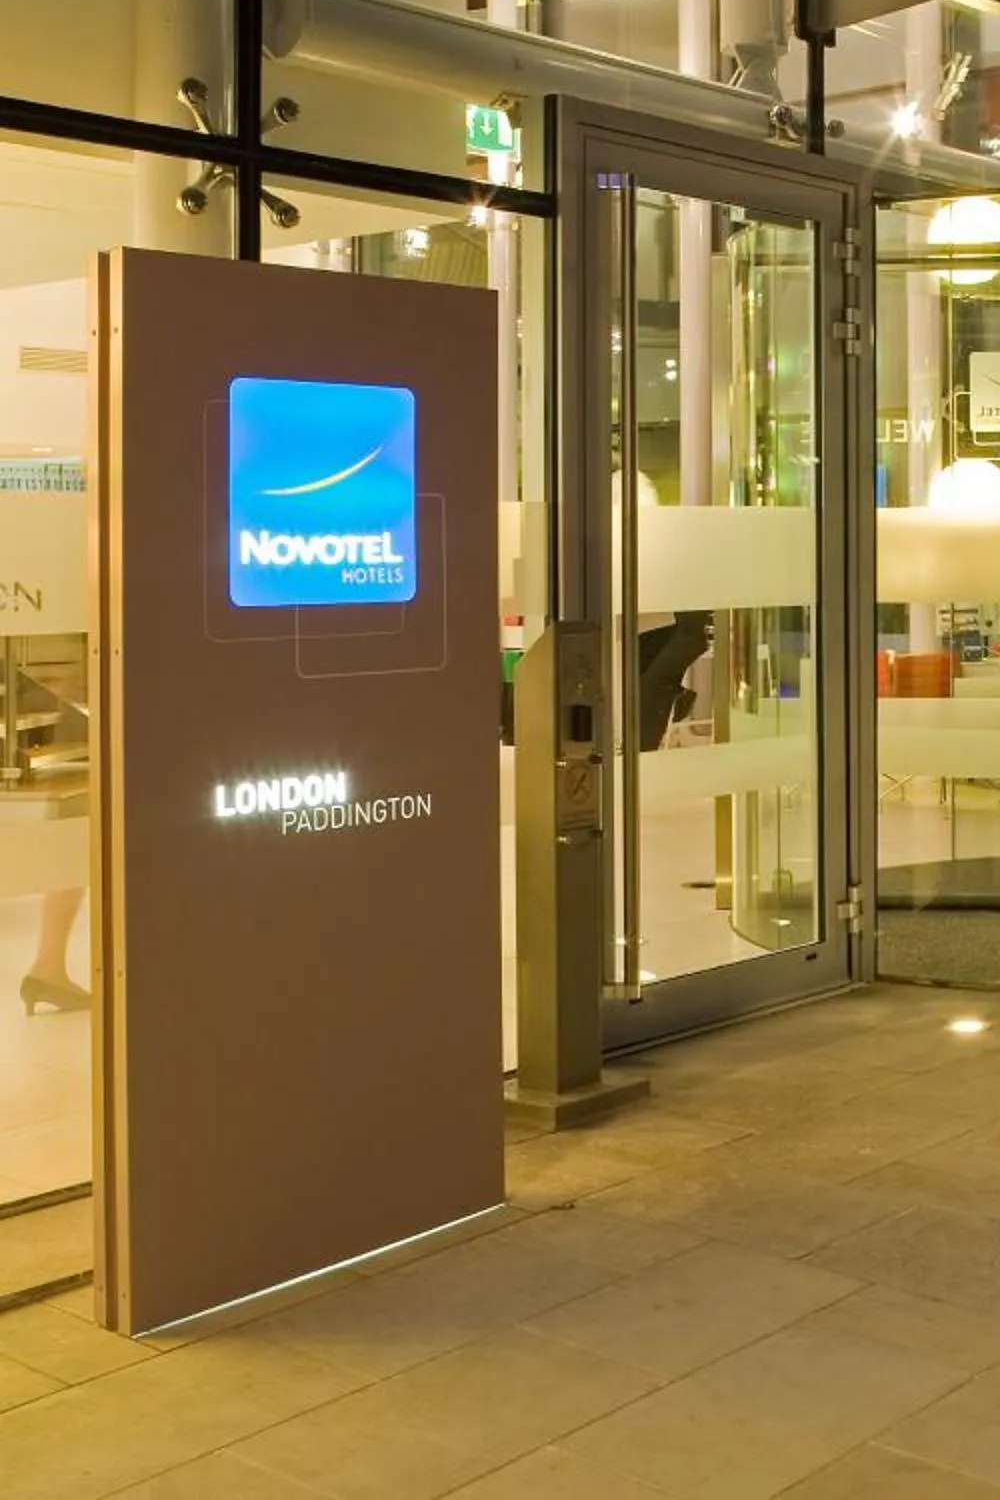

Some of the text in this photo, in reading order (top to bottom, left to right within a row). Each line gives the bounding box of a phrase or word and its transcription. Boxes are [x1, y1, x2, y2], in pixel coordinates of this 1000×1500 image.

[240, 530, 403, 565] NOVOTEL
[341, 567, 404, 584] HOTELS
[215, 771, 347, 817] LONDON
[281, 793, 432, 835] PADDINGTON
